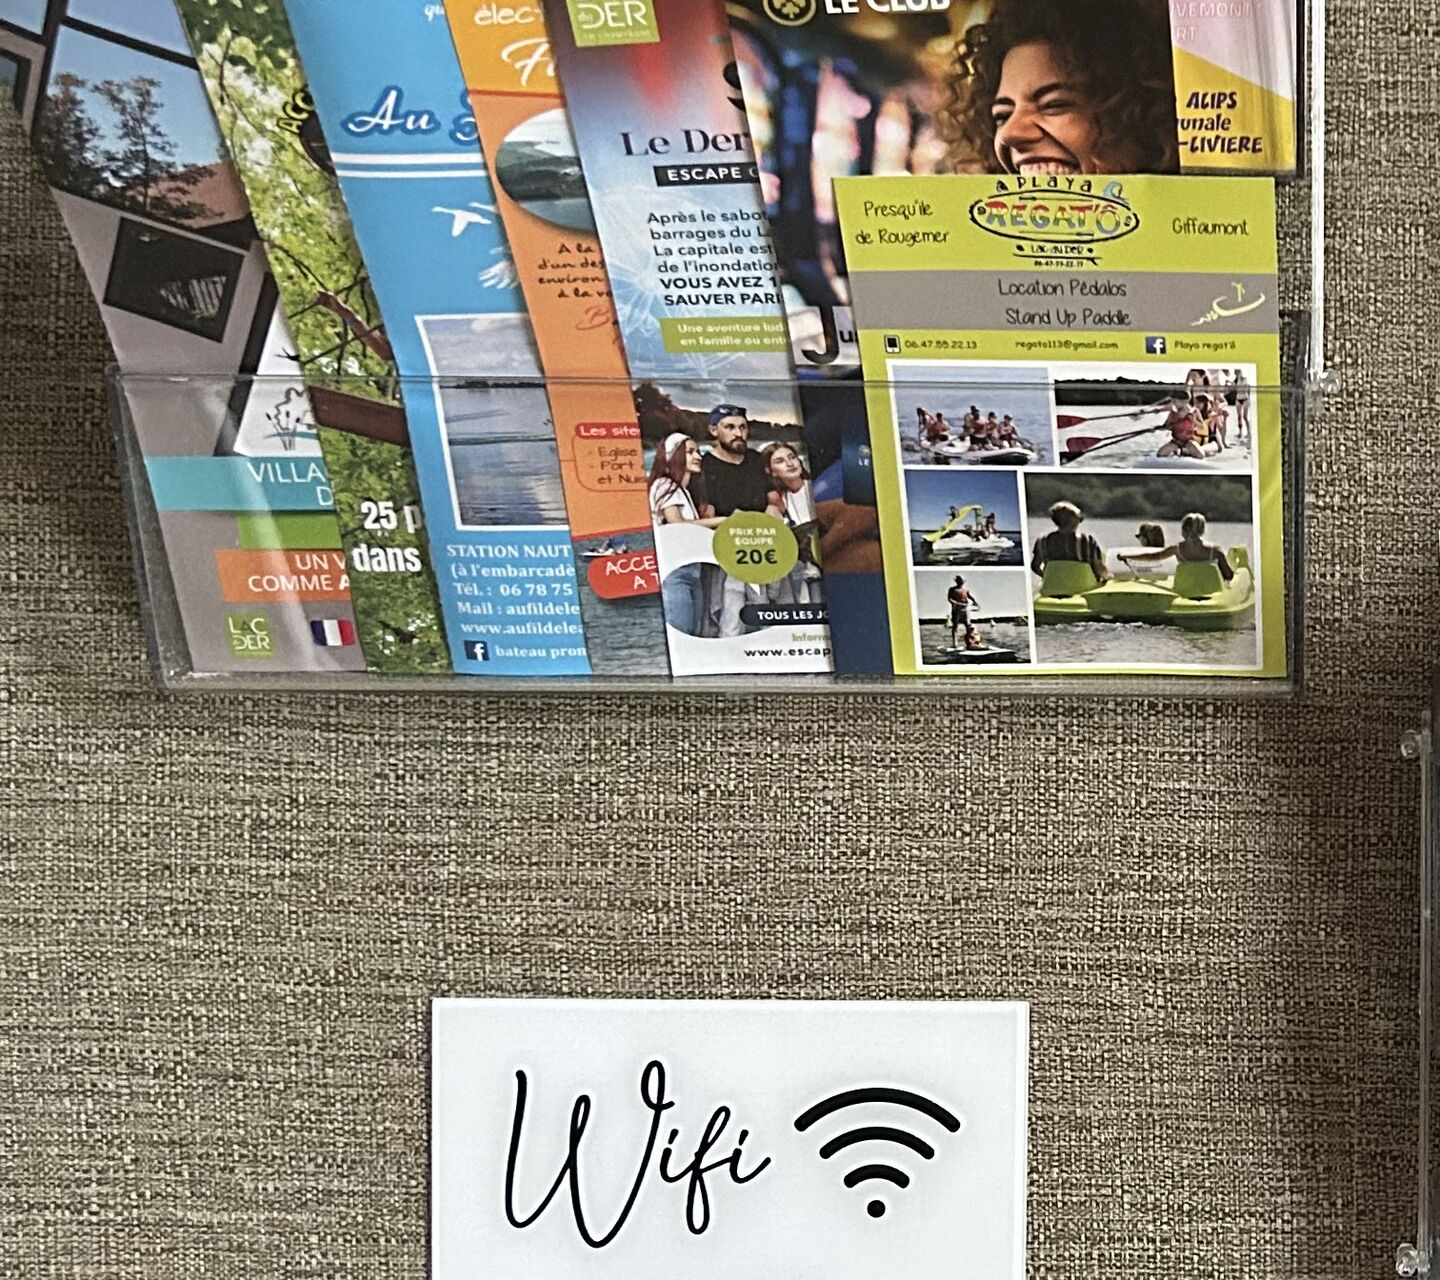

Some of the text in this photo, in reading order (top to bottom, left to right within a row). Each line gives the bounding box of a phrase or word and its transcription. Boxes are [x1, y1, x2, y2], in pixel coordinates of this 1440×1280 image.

[577, 1, 648, 29] DER
[1186, 91, 1237, 110] ALIPS
[348, 89, 436, 132] Au
[621, 131, 670, 156] Le
[667, 167, 741, 181] ESCAPE
[647, 209, 716, 227] Après le
[650, 226, 751, 242] barrages du
[1172, 218, 1249, 237] Giffaumont
[855, 228, 949, 247] de Rougemer
[654, 243, 744, 259] La capitale
[658, 261, 679, 273] de
[660, 276, 764, 289] VOUS AVEZ
[998, 278, 1127, 297] Location Pédalos
[664, 292, 736, 306] SAUVER
[1006, 308, 1132, 328] Stand Up Paddle
[677, 323, 759, 334] Une aventure
[700, 335, 742, 346] famille
[580, 425, 609, 438] Les
[360, 501, 398, 530] 25
[352, 543, 422, 572] dans
[447, 544, 572, 558] STATION NAUT
[736, 549, 778, 564] 20€
[295, 554, 329, 570] UN
[248, 575, 333, 592] COMME
[500, 584, 573, 596] 06 78 75
[457, 602, 493, 615] Mail
[758, 610, 813, 620] TOUS LES
[505, 1059, 771, 1249] Wifi
